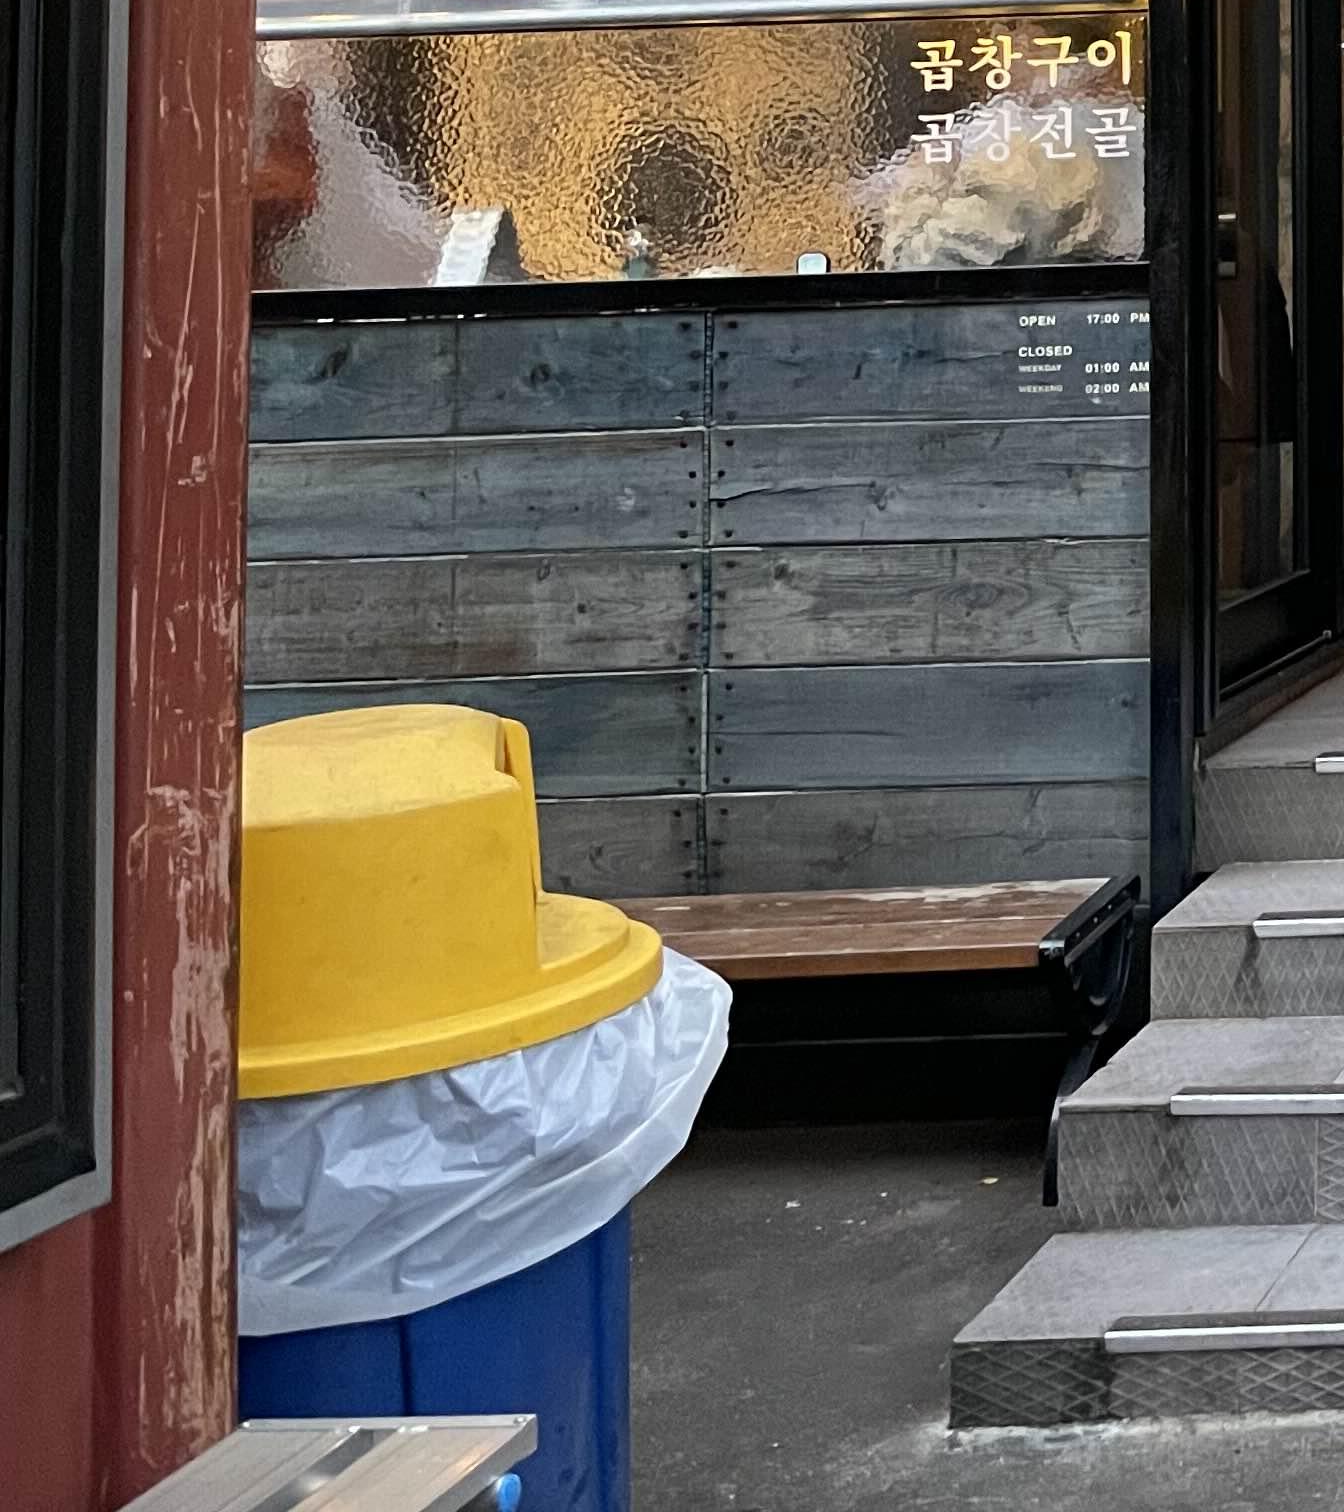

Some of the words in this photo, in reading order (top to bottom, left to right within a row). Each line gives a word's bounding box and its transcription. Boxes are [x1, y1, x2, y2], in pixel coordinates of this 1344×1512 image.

[910, 31, 1132, 92] 곱창구이
[911, 106, 1137, 164] 곱창전골
[1018, 315, 1056, 327] OPEN
[1086, 313, 1120, 324] 17:00
[1130, 312, 1150, 323] PM
[1018, 345, 1073, 357] CLOSED
[1018, 364, 1062, 373] WEEKDAY
[1085, 362, 1120, 373] 01:00
[1129, 361, 1150, 372] AM
[1085, 383, 1120, 394] 02:00
[1129, 382, 1150, 393] AM
